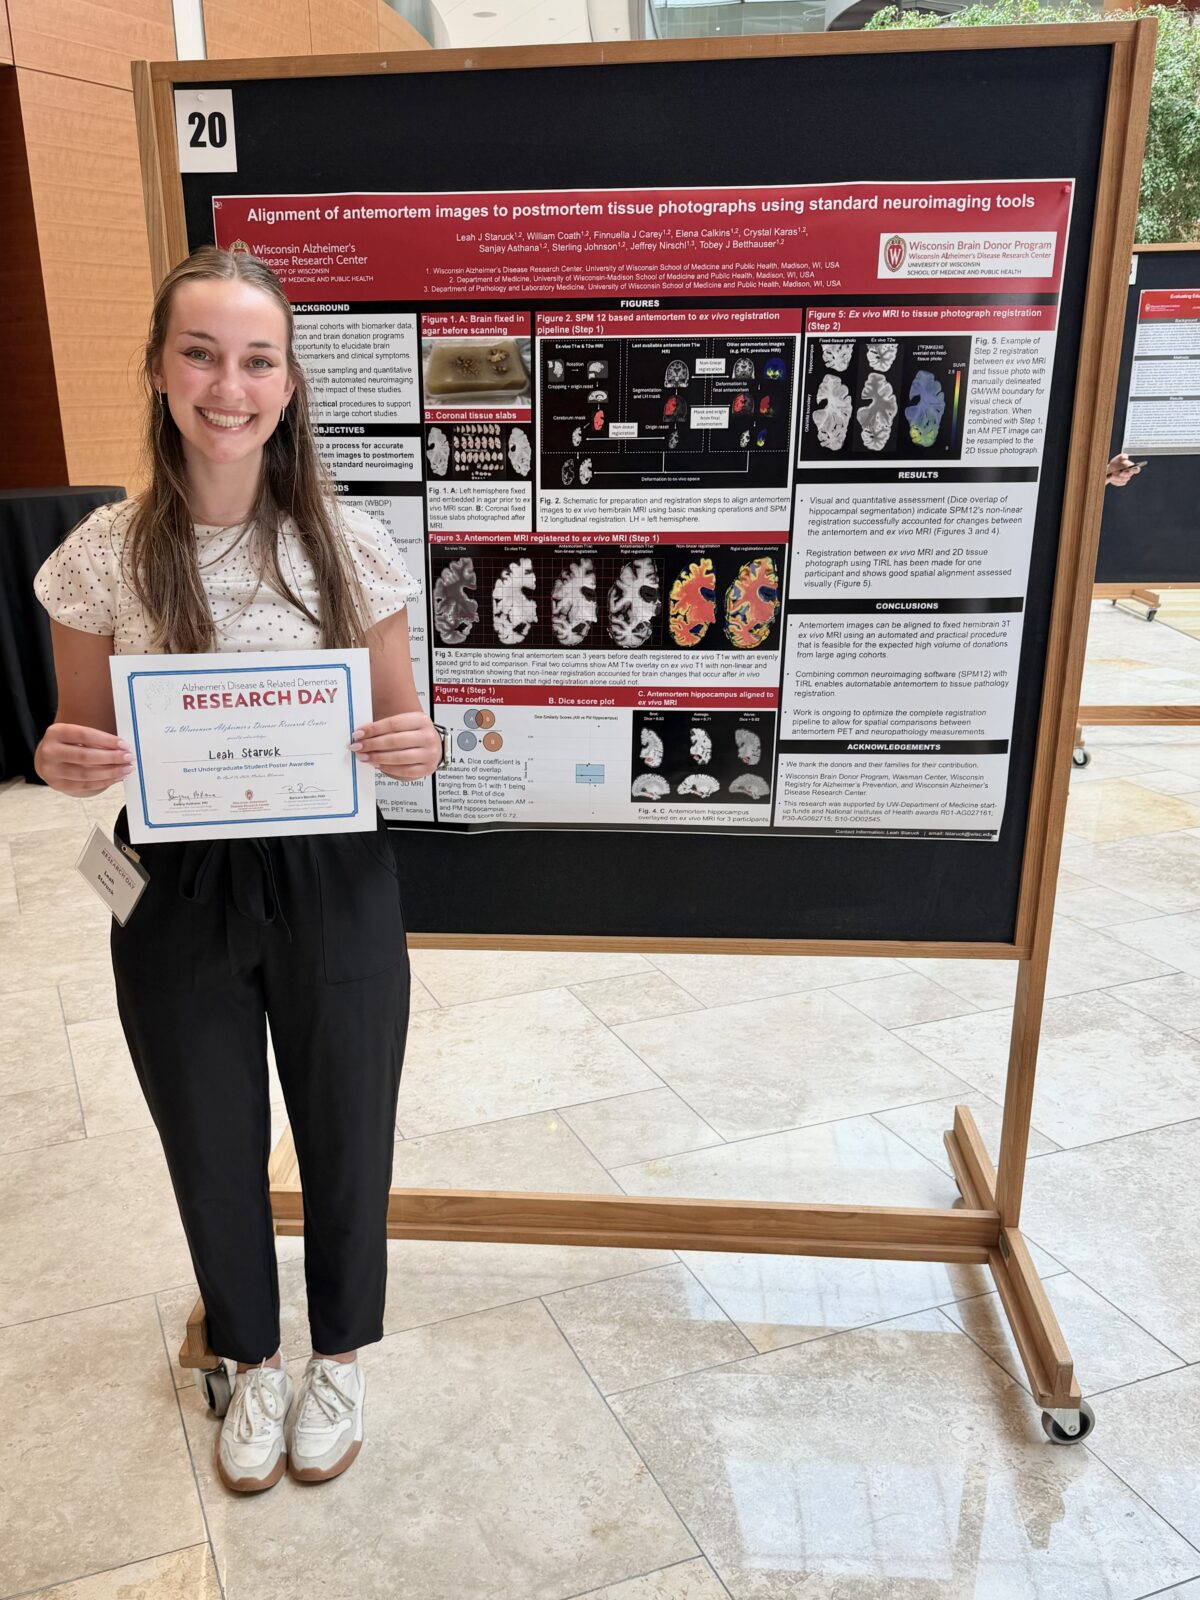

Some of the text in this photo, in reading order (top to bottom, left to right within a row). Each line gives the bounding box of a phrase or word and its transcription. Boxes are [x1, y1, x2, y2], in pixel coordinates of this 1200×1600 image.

[187, 111, 227, 148] 20
[247, 193, 1034, 224] Alignment of antemortem images to postmortem tissue photographs using standard neuroimaging tools
[250, 242, 356, 256] Wisconsin Alzheimer's
[908, 240, 1052, 253] Wisconsin Brain Donor Program
[291, 254, 333, 265] Research
[335, 254, 368, 264] Center
[291, 304, 350, 312] BACKGROUND
[620, 299, 659, 307] FIGURES
[421, 314, 524, 325] Figure 1. A: Brain fixed in
[536, 314, 563, 324] Figure
[565, 313, 572, 322] 2.
[575, 313, 594, 322] SPM
[596, 313, 606, 321] 12
[608, 313, 633, 321] based
[635, 313, 685, 321] antemortem
[687, 312, 696, 320] to
[711, 311, 729, 320] vivo
[730, 311, 779, 321] registration
[808, 308, 1041, 320] Figure 5: Ex vivo MRI to tissue photograph registration
[422, 325, 507, 336] agar before scanning
[536, 324, 603, 335] pipeline (Step 1)
[807, 321, 840, 331] (Step 2)
[975, 336, 1040, 346] Fig. 5. Example of
[424, 411, 516, 421] B: Coronal tissue slabs
[312, 426, 364, 435] OBJECTIVES
[809, 496, 833, 504] Visual
[834, 496, 850, 504] and
[851, 496, 896, 505] quantitative
[946, 495, 967, 504] (Dice
[969, 496, 998, 504] overlap
[999, 495, 1008, 503] of
[808, 507, 858, 516] hippocampal
[859, 506, 915, 516] segmentation)
[916, 506, 947, 514] indicate
[428, 533, 453, 544] Figure
[455, 534, 462, 544] 3.
[463, 534, 511, 544] Antemortem
[530, 534, 570, 544] registered
[571, 534, 580, 542] to
[581, 535, 591, 545] ex
[593, 534, 610, 542] vivo
[628, 534, 650, 545] (Step
[652, 534, 659, 544] 1)
[181, 680, 225, 691] Alzheimer's
[227, 680, 257, 690] Disease
[266, 678, 295, 688] Related
[297, 677, 338, 690] Dementias
[434, 685, 458, 696] Figure
[466, 686, 486, 697] (Step
[488, 687, 495, 695] 1)
[646, 690, 689, 701] Antemortem
[738, 691, 765, 699] aligned
[182, 687, 337, 710] RESEARCH DAY
[599, 698, 614, 706] plot
[208, 746, 281, 760] Leah Staruck
